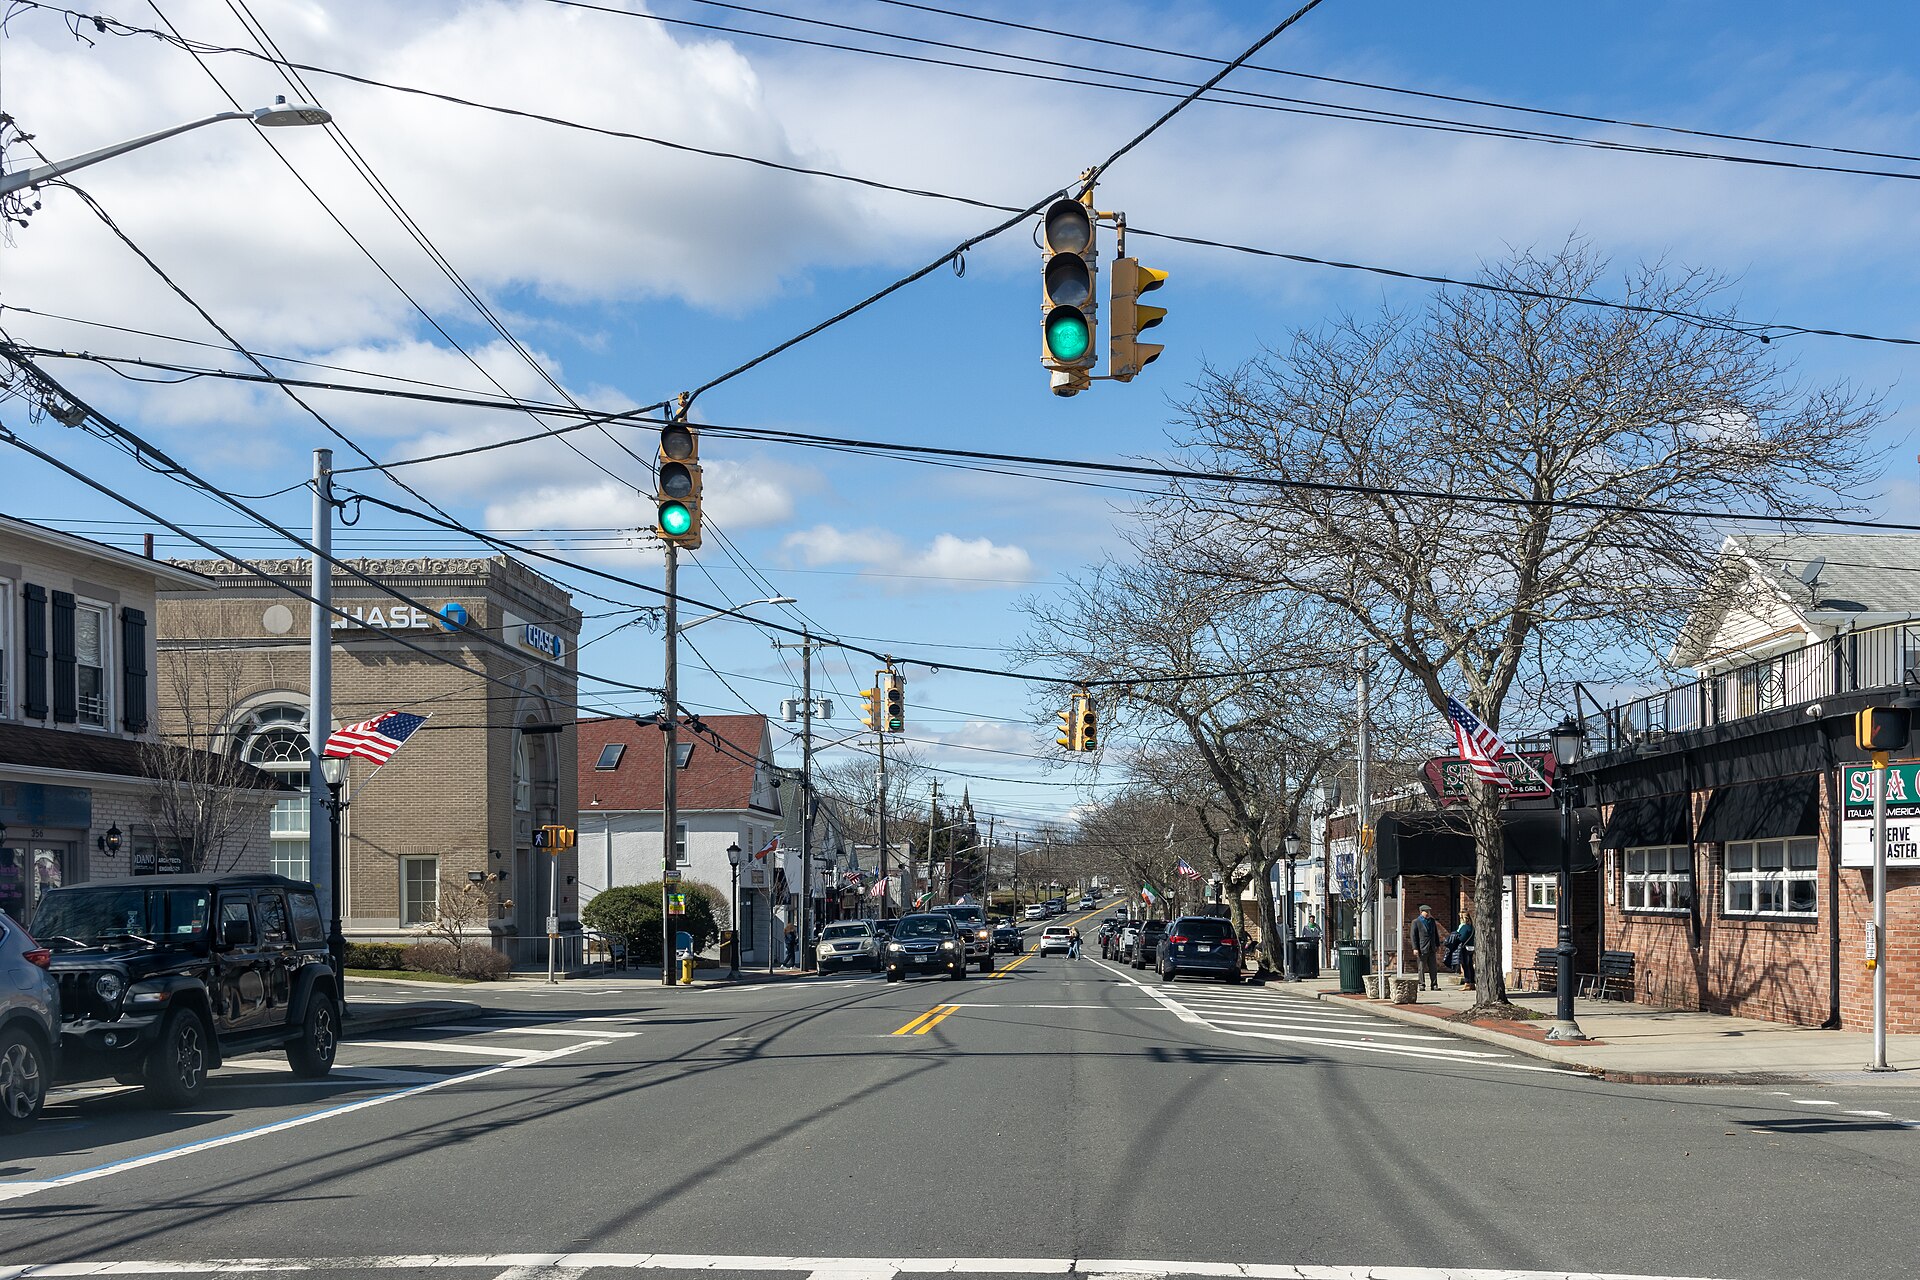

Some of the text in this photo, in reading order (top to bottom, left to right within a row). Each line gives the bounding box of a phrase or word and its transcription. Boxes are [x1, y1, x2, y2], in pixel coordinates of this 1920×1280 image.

[526, 624, 554, 655] CHASE
[1848, 809, 1874, 817] ITALIA
[32, 829, 44, 838] 356
[1870, 827, 1910, 842] RERVE
[1887, 843, 1917, 858] ASTER
[134, 855, 155, 864] DANO
